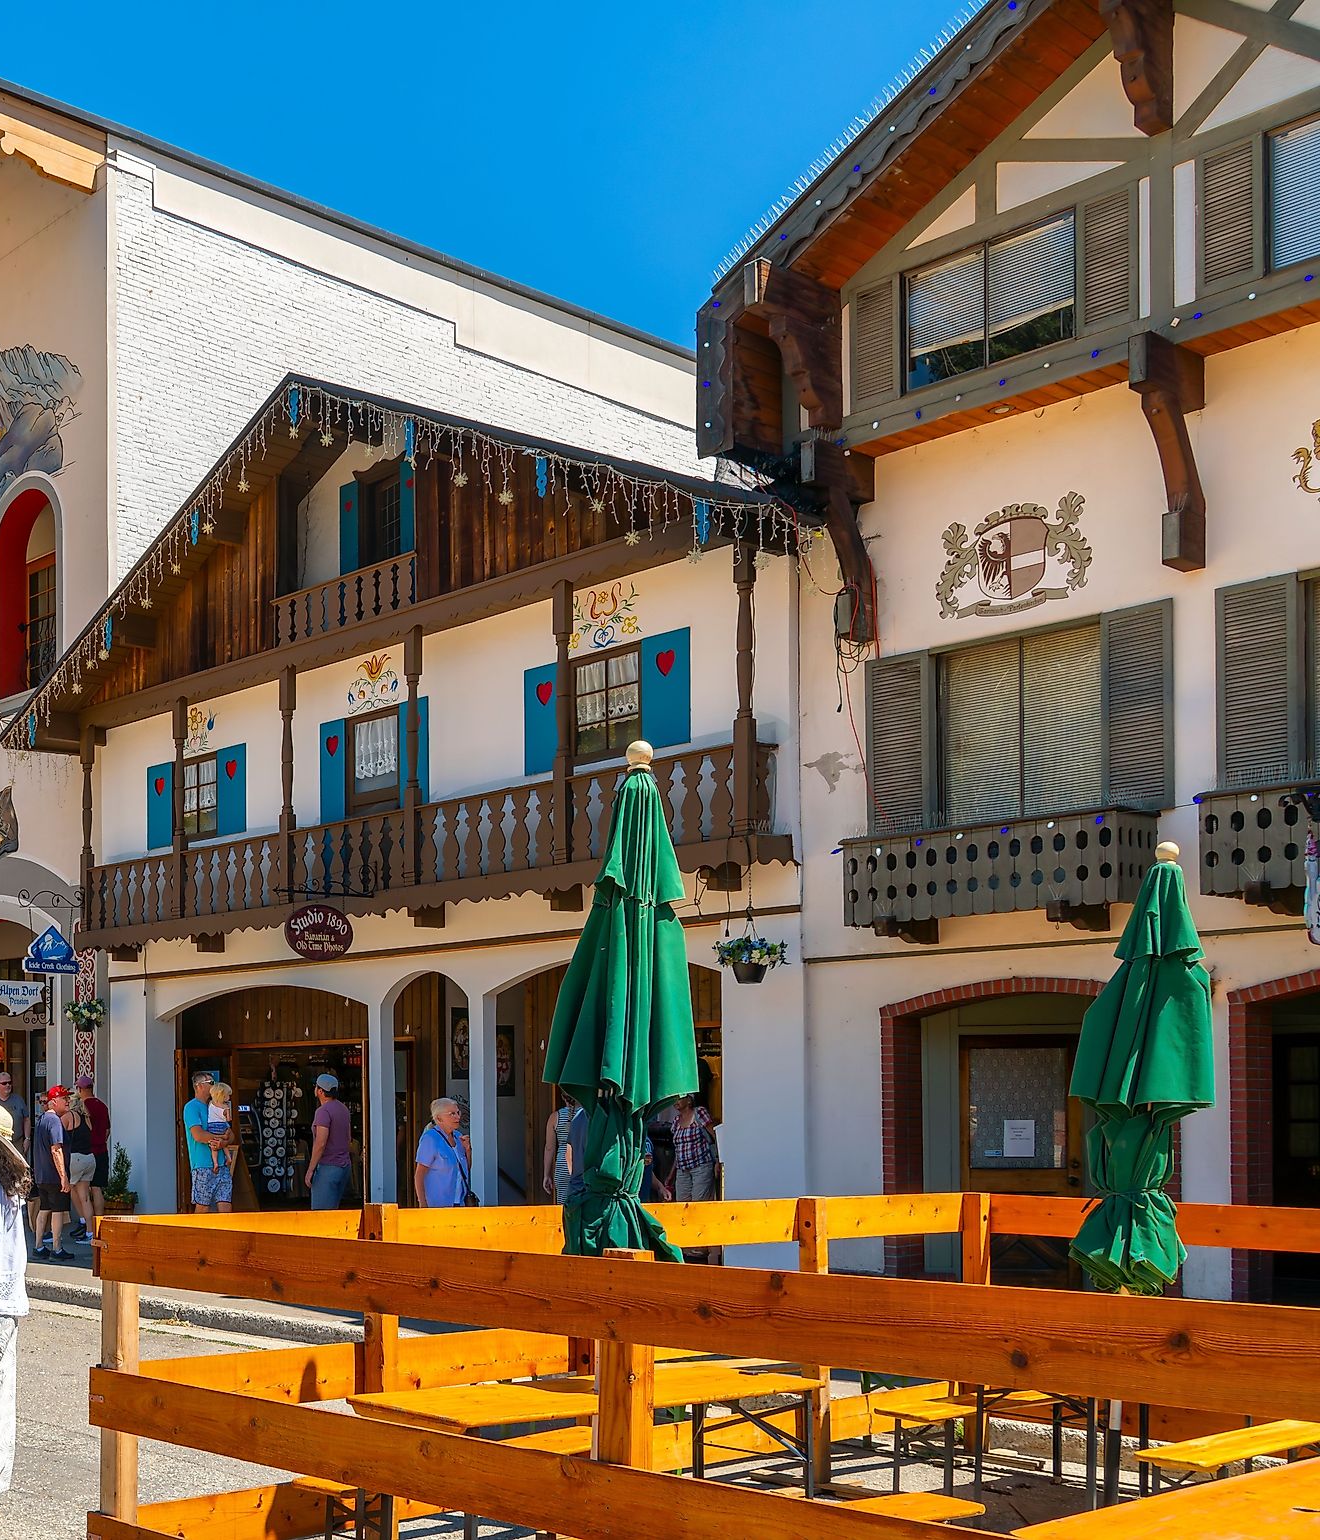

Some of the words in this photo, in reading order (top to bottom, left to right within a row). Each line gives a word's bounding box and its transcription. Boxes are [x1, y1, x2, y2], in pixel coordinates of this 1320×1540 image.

[291, 908, 323, 935] Studio
[327, 913, 347, 935] 1890
[304, 931, 329, 941] Bavarian
[296, 940, 308, 950] Old
[323, 941, 344, 953] Photos
[41, 962, 55, 970] Creek
[56, 963, 76, 972] Clothing
[0, 984, 20, 997] Alpen
[22, 985, 39, 996] Dorf
[9, 997, 29, 1006] Pension
